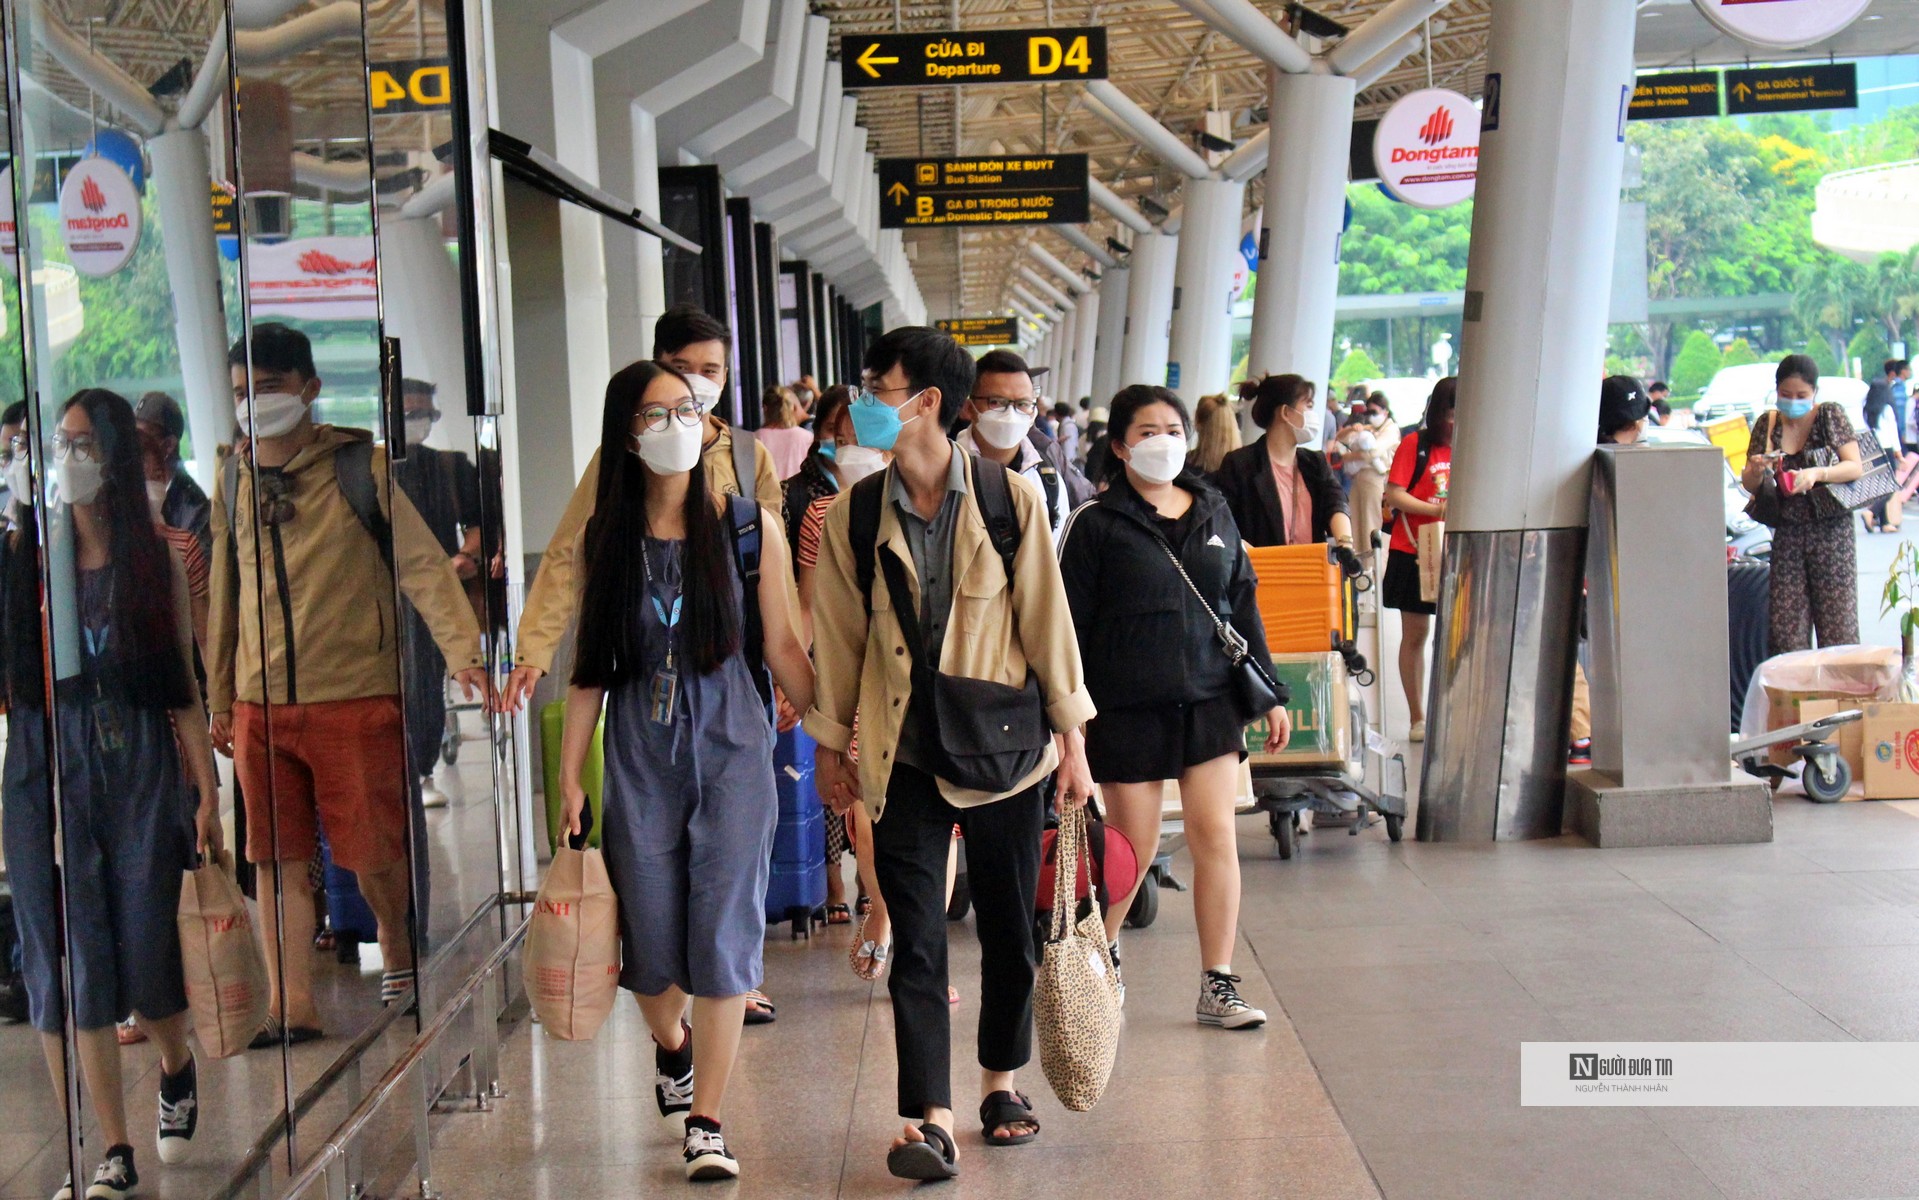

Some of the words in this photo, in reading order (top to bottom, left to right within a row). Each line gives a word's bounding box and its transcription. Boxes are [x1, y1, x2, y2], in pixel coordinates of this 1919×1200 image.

[925, 38, 963, 58] CỬA
[967, 42, 985, 57] ĐI
[1028, 35, 1092, 75] D4
[926, 62, 1001, 79] Departure
[1654, 85, 1689, 95] TRONG
[1756, 81, 1771, 90] GA
[1756, 91, 1809, 100] International
[1809, 89, 1846, 98] Terminal
[1656, 97, 1689, 106] Arrivals
[1391, 146, 1479, 164] Dongtam
[1006, 161, 1021, 171] XE
[945, 175, 965, 184] Bus
[967, 174, 1003, 184] Station
[916, 196, 934, 217] B
[945, 199, 963, 210] GA
[979, 197, 1019, 209] TRONG
[945, 211, 993, 222] Domestic
[993, 211, 1049, 221] Departures
